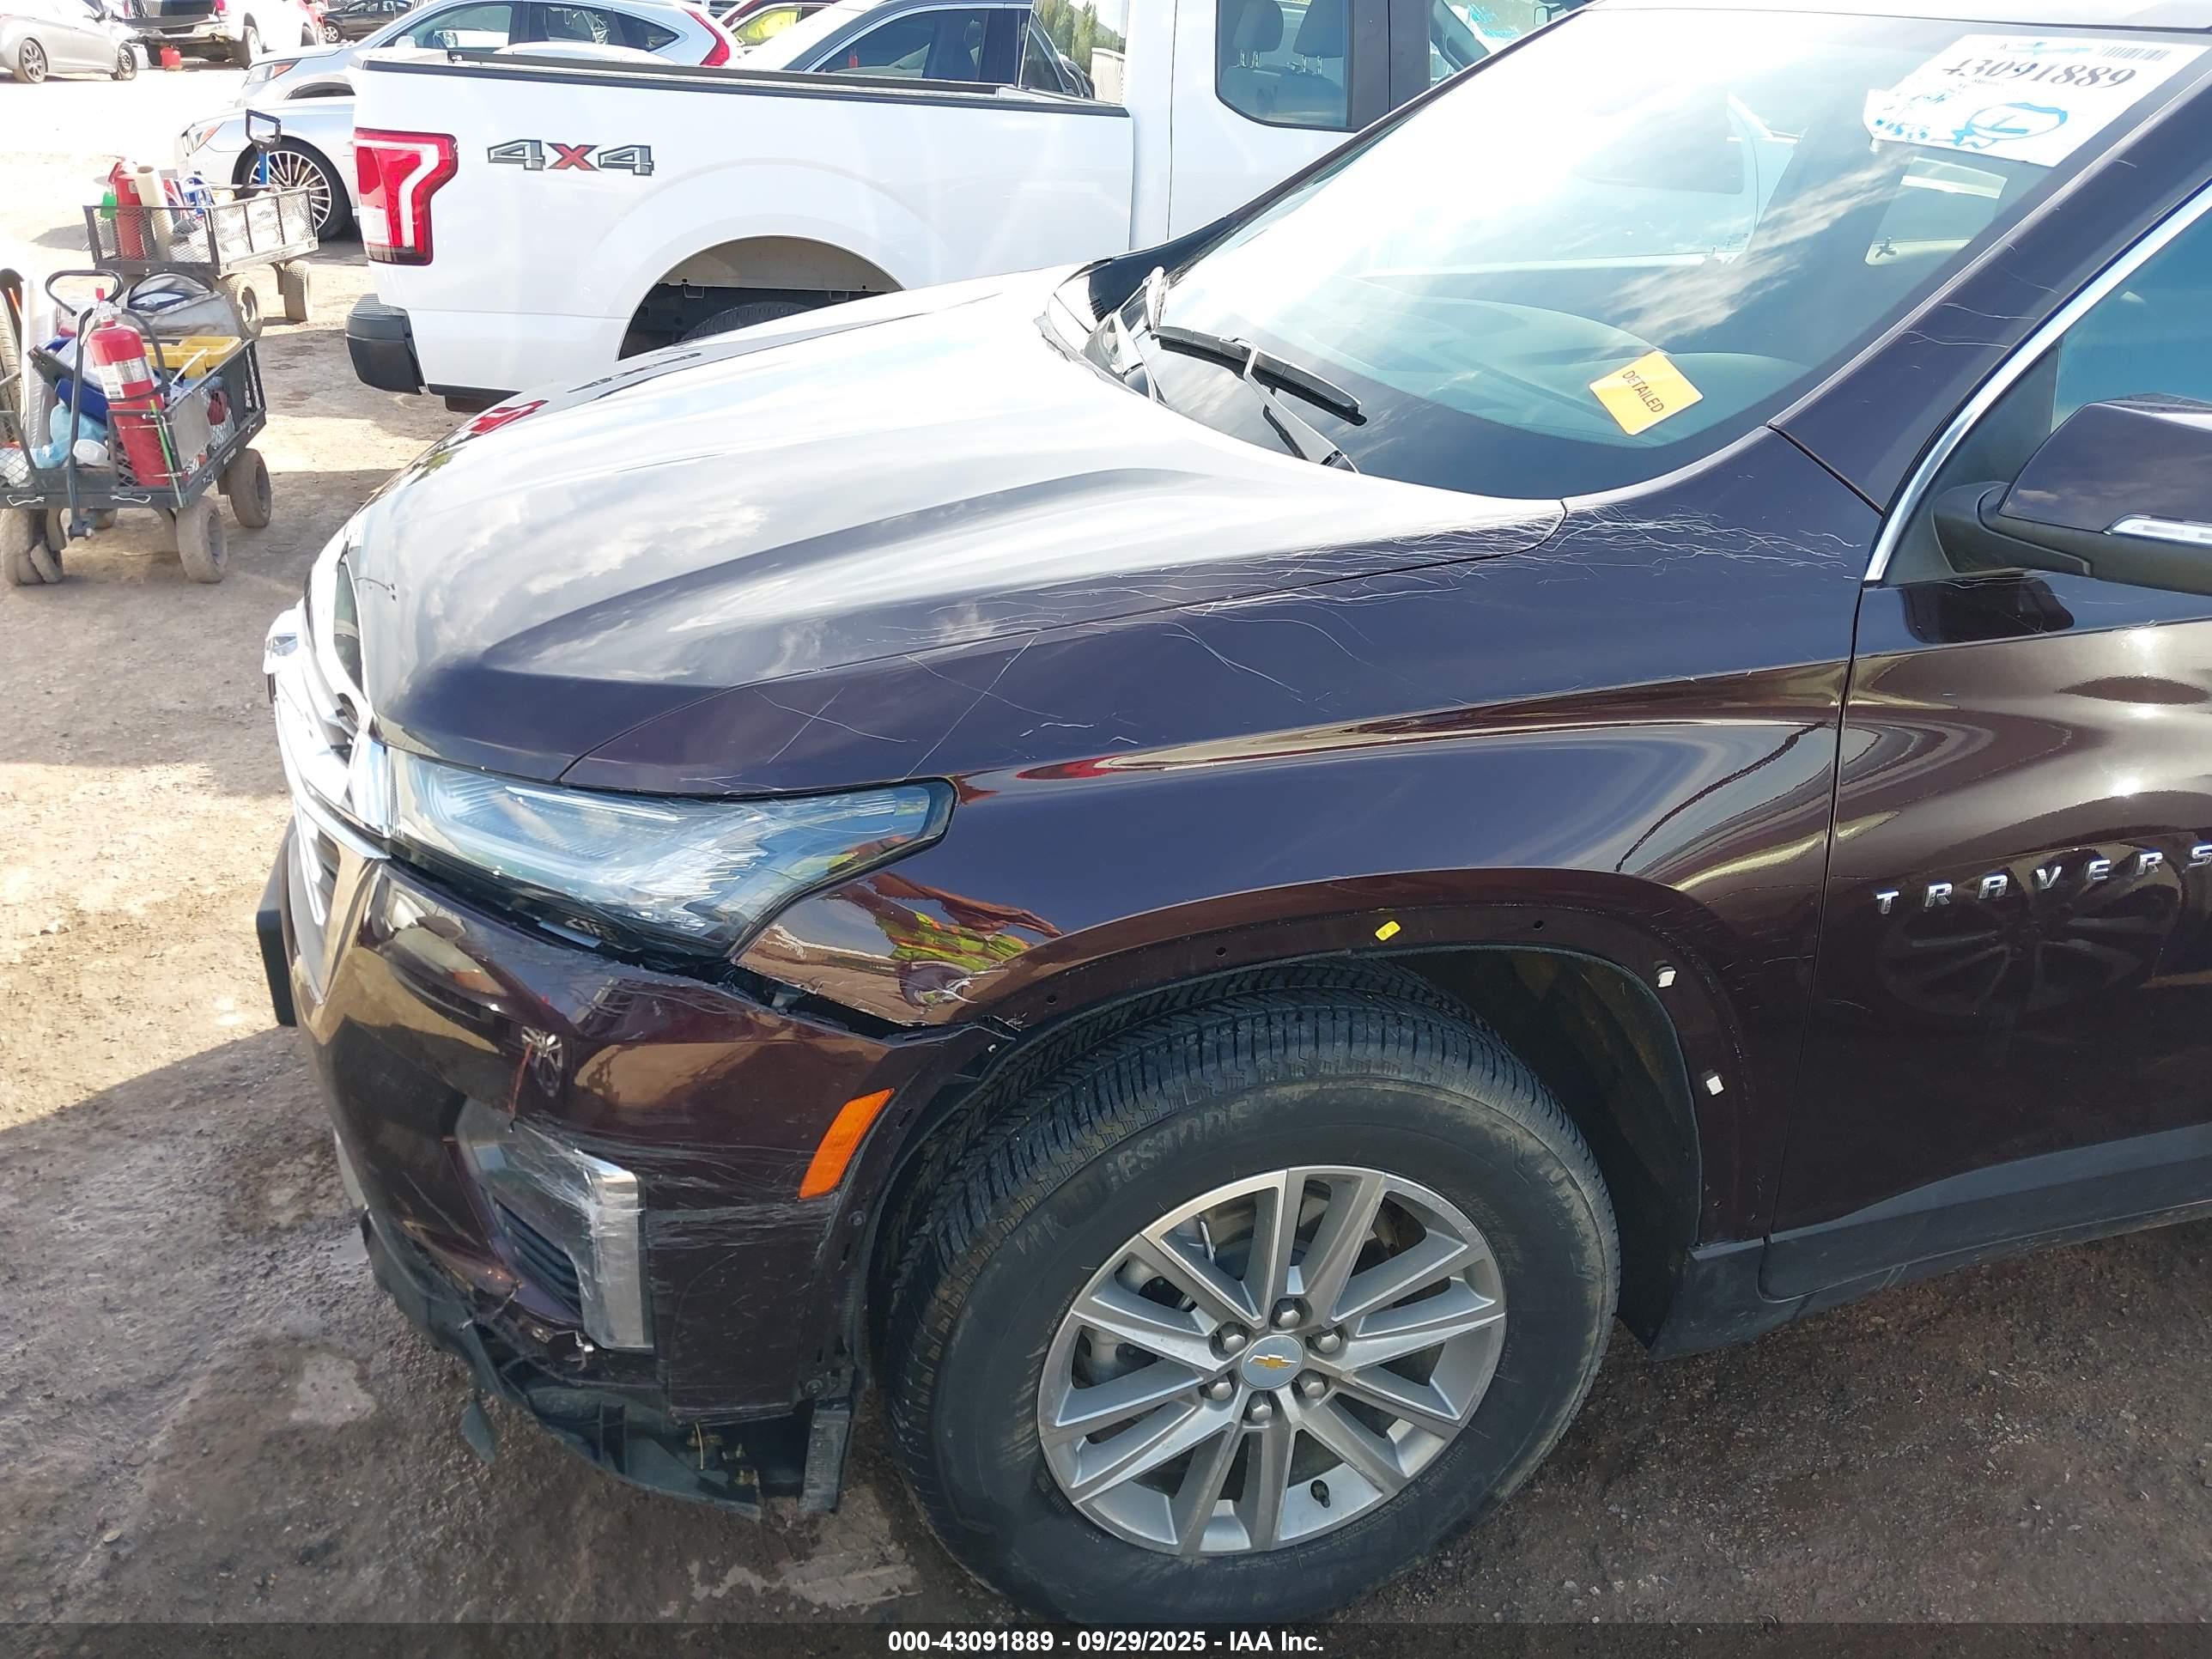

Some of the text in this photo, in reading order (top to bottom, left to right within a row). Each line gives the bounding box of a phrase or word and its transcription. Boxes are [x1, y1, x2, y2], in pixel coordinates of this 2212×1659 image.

[1942, 58, 2137, 89] 43091889
[1621, 369, 1665, 414] DETAILED
[1875, 842, 2212, 915] TRAVERS
